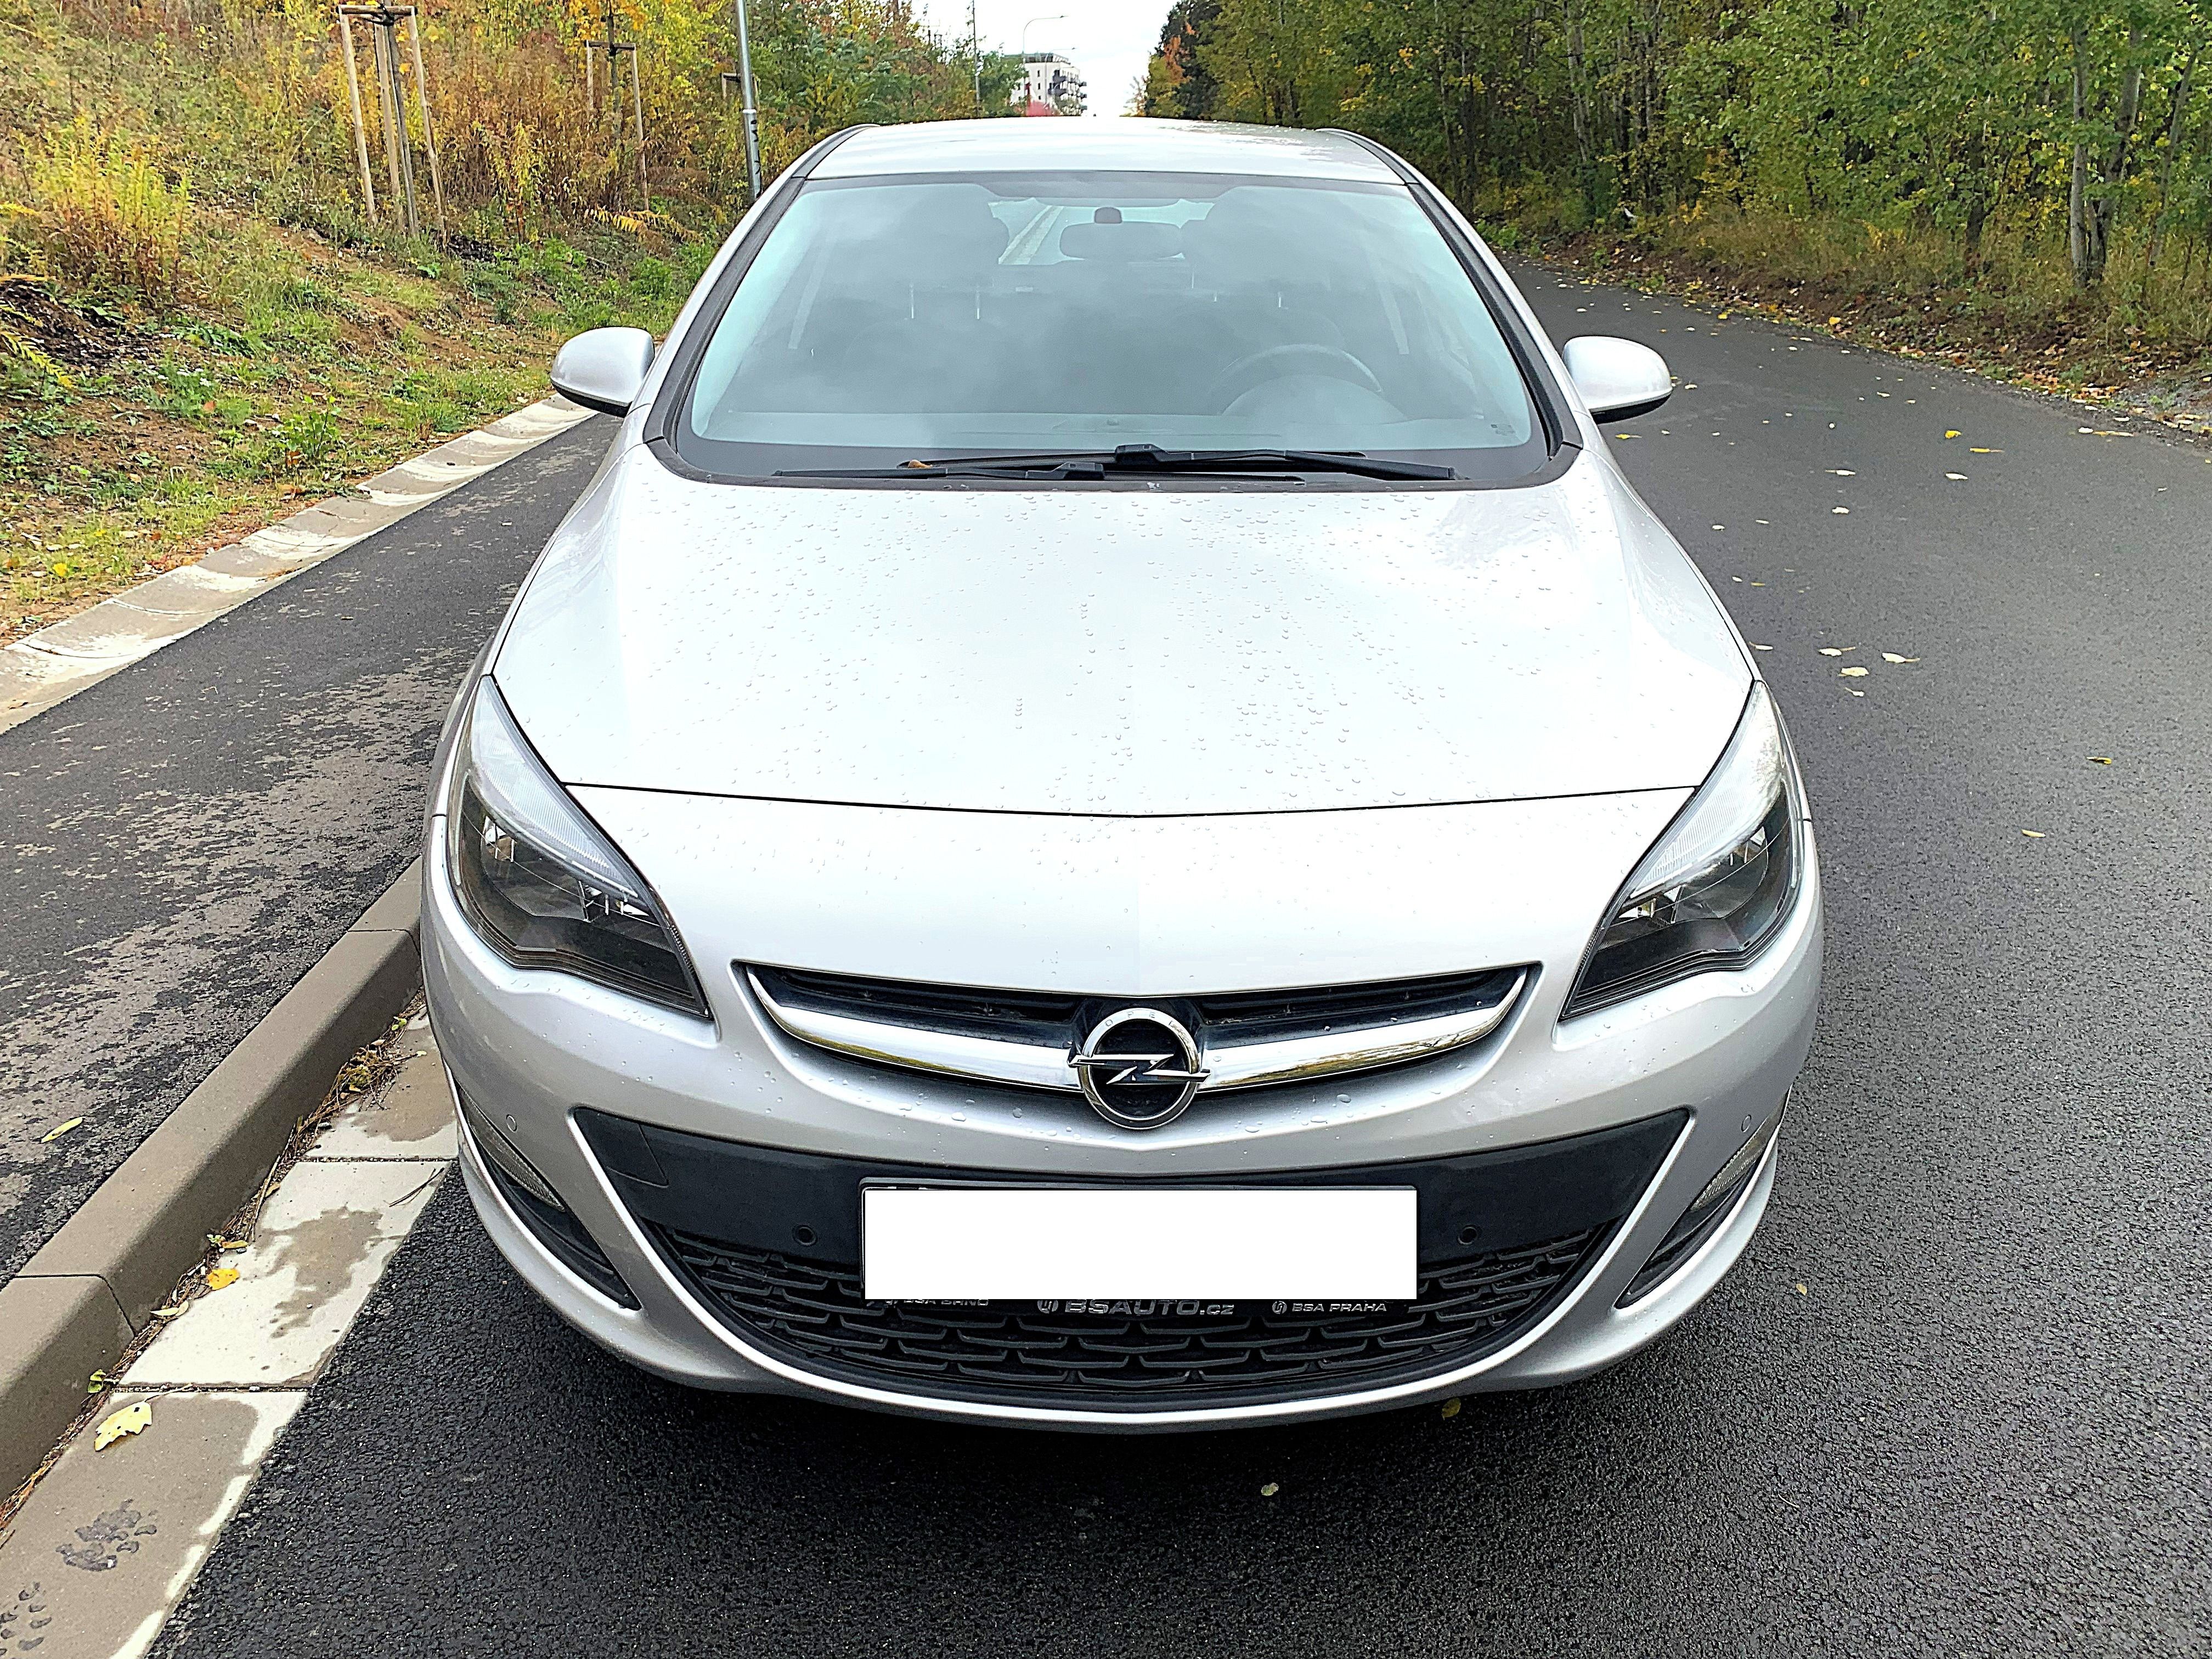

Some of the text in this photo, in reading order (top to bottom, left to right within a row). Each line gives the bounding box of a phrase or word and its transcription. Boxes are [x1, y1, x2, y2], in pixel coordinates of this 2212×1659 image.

[1104, 1011, 1175, 1028] OPEL
[1064, 1299, 1234, 1315] BSAUTO.cz
[1292, 1303, 1387, 1312] BSA PRAHA
